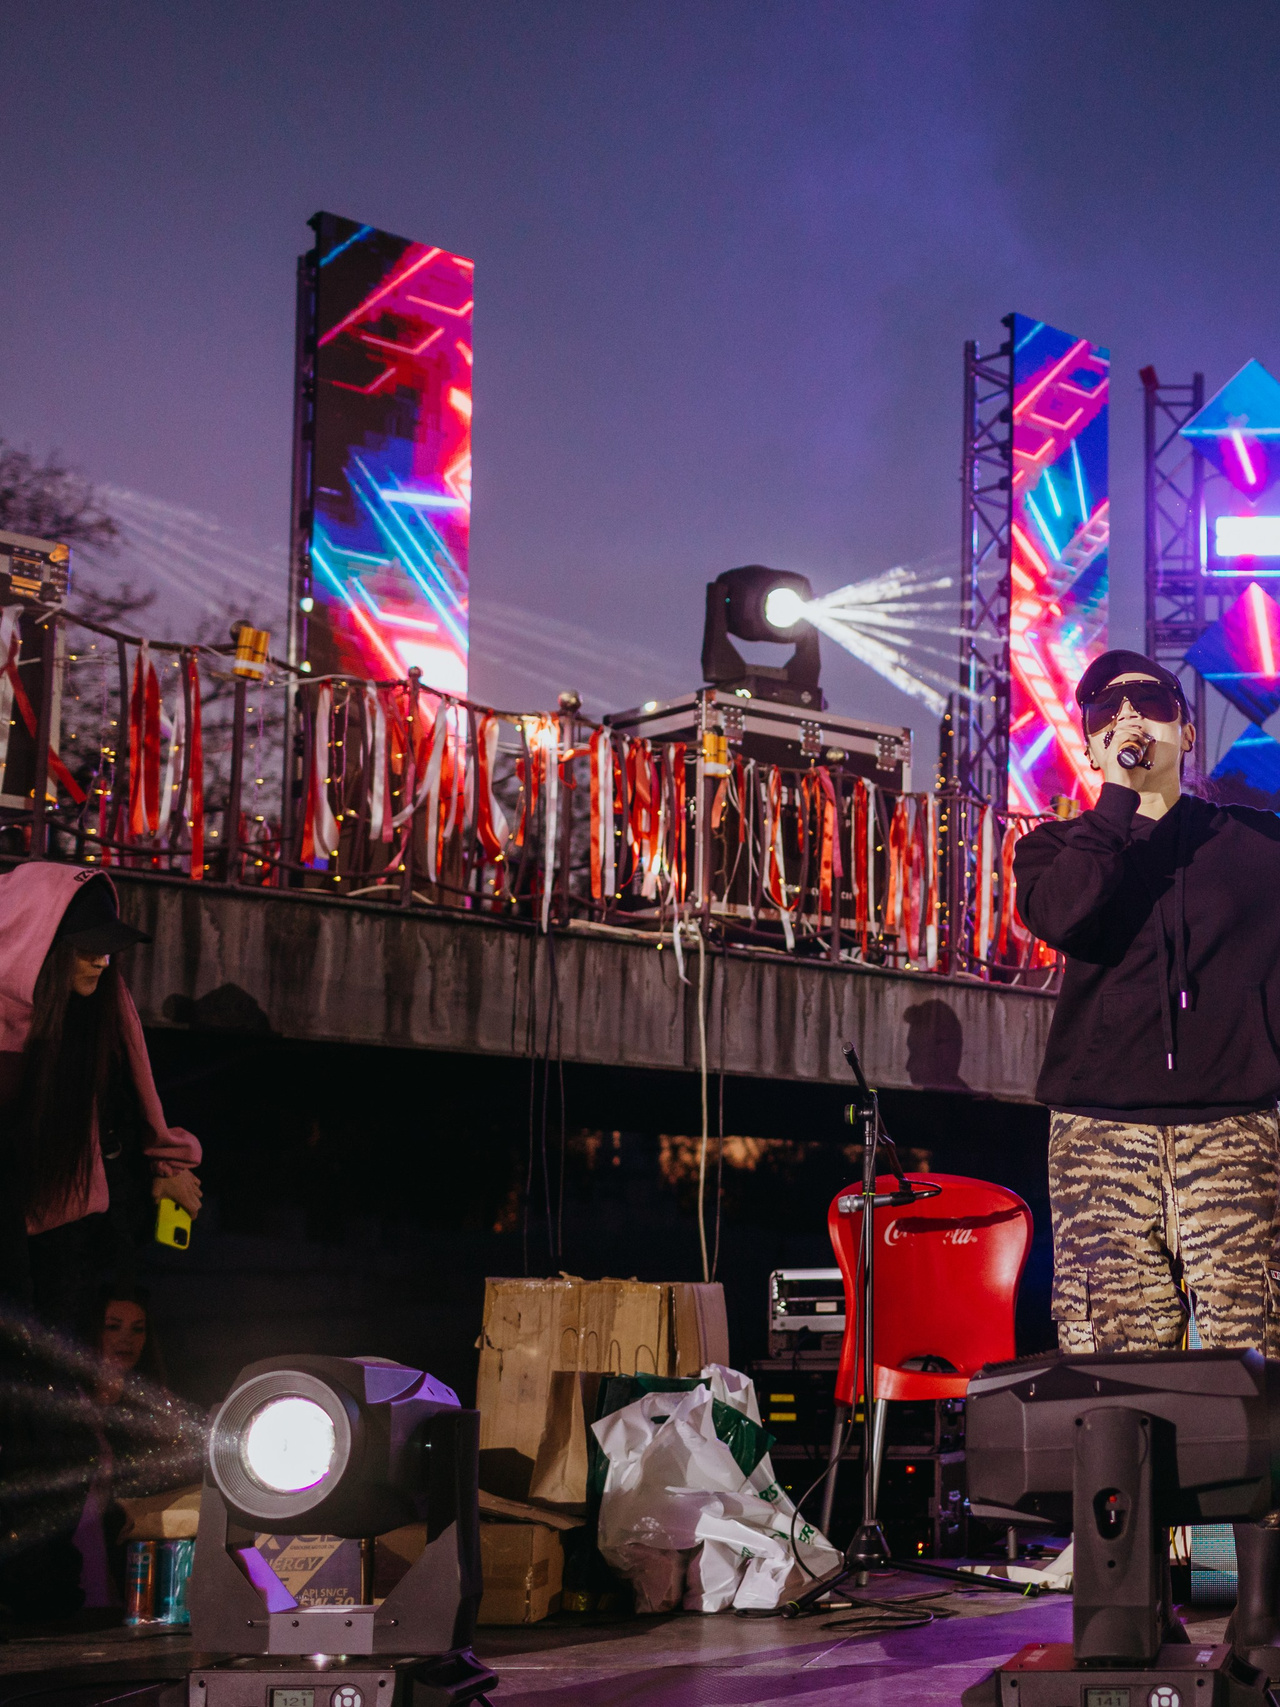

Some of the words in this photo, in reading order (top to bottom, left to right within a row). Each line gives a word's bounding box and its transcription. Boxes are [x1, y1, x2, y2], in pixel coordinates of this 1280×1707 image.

[320, 1587, 349, 1597] SN/CF
[282, 1697, 306, 1707] 121
[1096, 1697, 1121, 1706] 141
